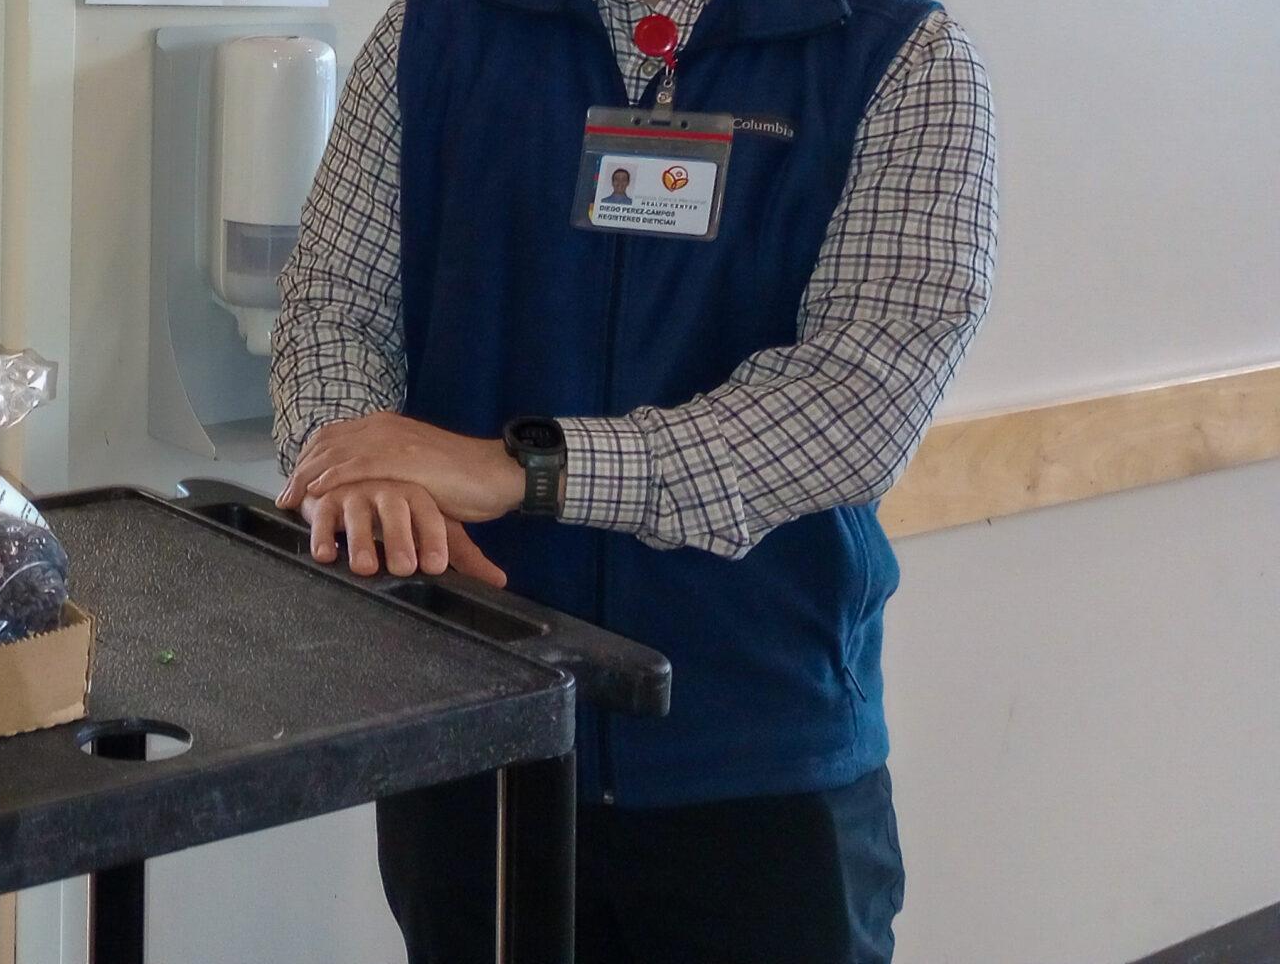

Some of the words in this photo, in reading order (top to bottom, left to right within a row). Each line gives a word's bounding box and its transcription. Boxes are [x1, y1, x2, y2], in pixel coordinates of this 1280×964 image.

[732, 117, 794, 137] Columbia
[599, 205, 621, 213] DIEGO
[598, 214, 641, 224] REGISTERED
[642, 217, 676, 226] DIETICIAN
